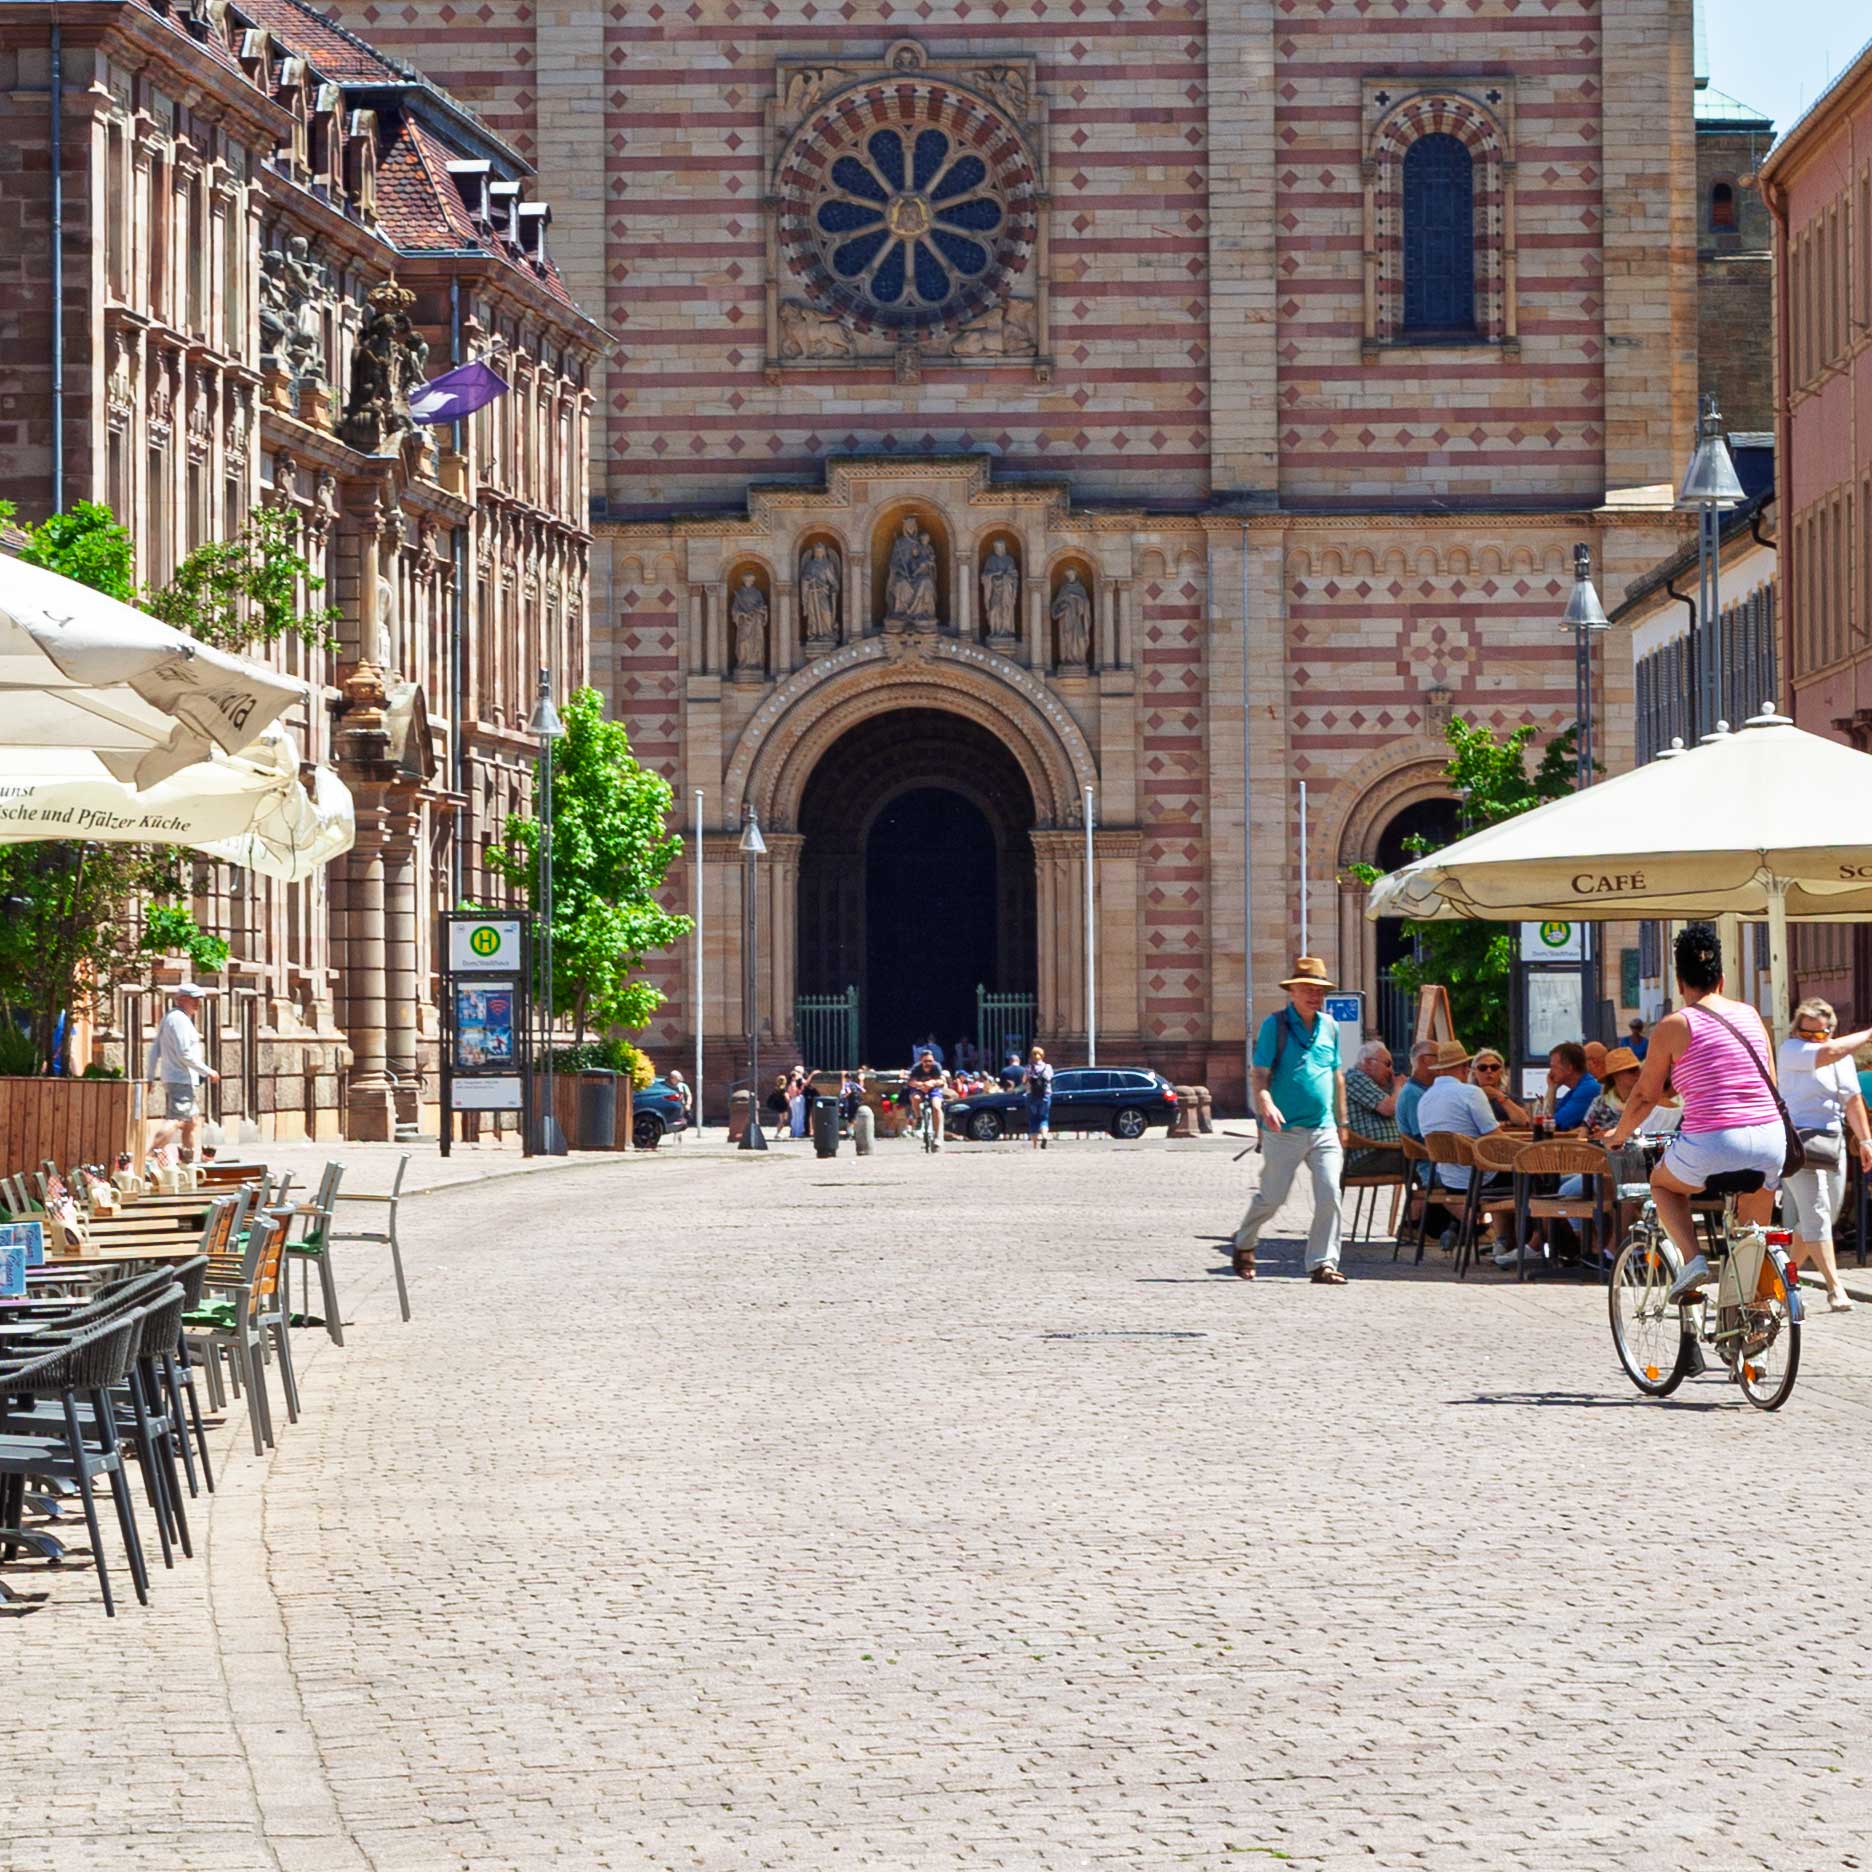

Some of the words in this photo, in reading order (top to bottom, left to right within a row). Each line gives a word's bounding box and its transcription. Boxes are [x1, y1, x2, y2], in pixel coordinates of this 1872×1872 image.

[40, 808, 73, 825] und
[77, 808, 135, 830] Pfälzer
[137, 813, 192, 833] Küche
[1571, 870, 1647, 894] CAFÉ
[478, 932, 493, 950] H
